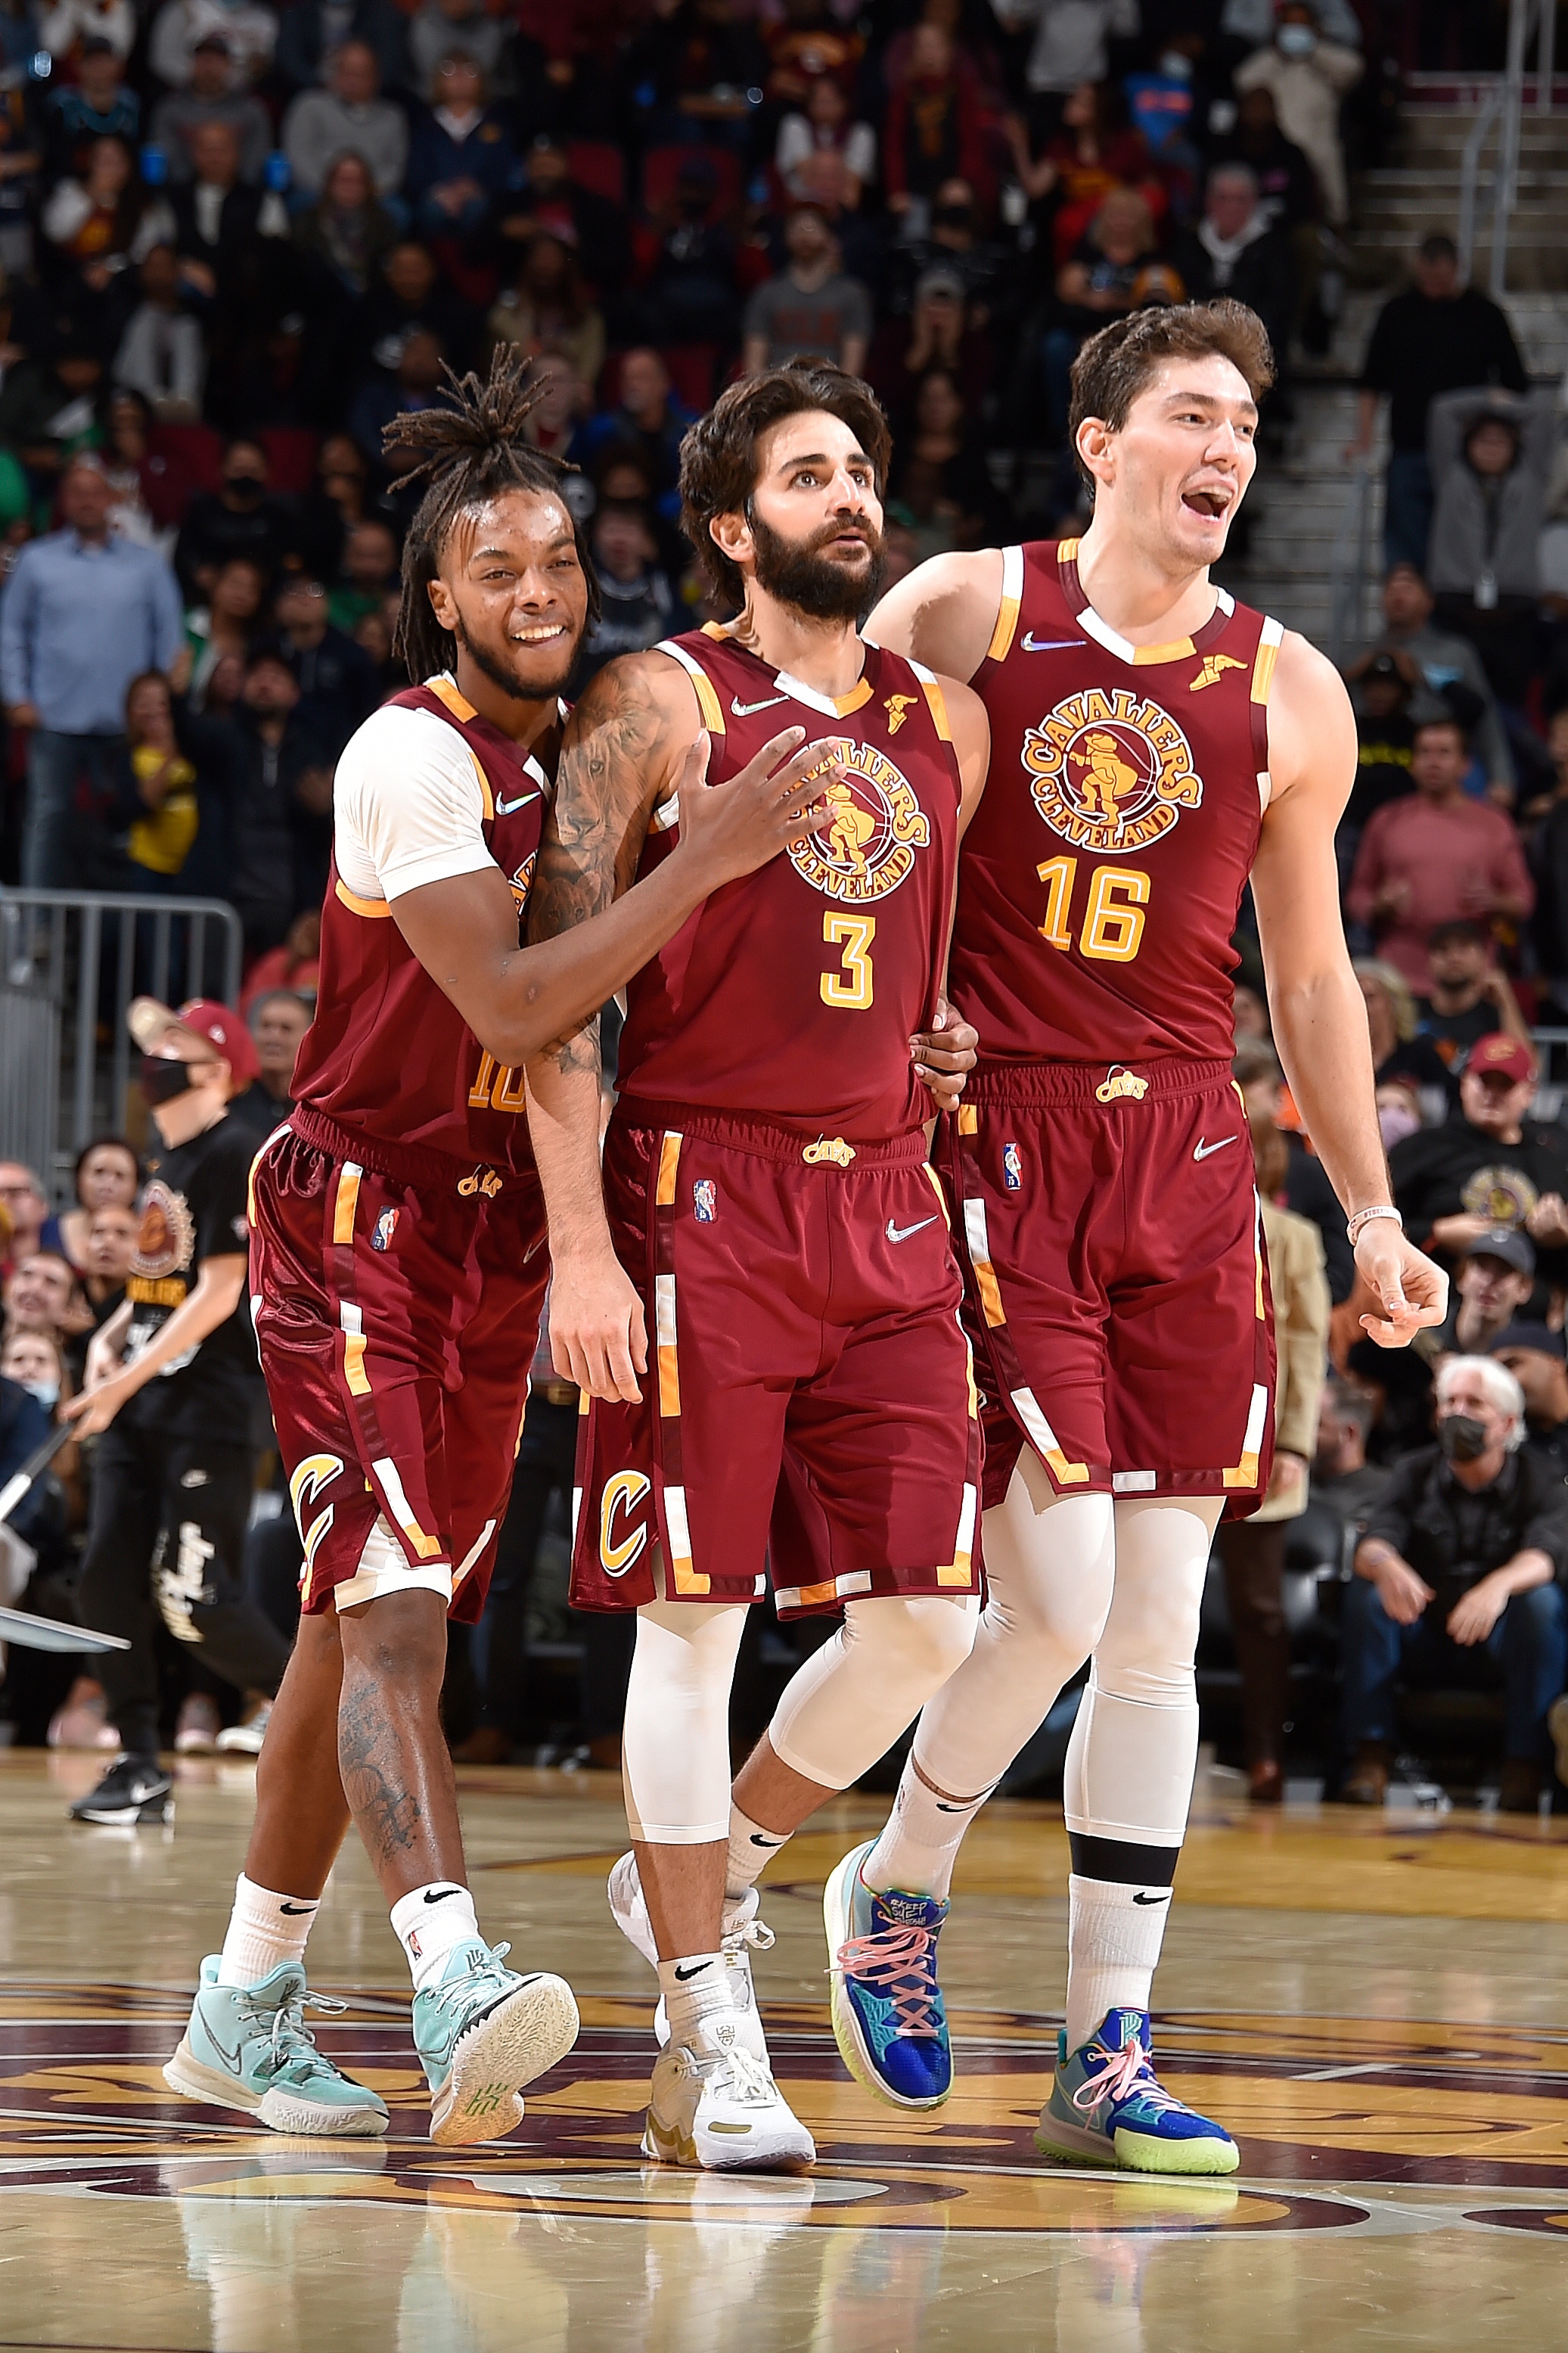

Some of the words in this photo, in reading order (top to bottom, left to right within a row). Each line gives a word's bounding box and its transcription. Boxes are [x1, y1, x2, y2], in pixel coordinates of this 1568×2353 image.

[788, 737, 930, 847] LIERS
[1022, 689, 1203, 807] CAVALIERS
[1031, 774, 1178, 853] CLEVELAND
[787, 836, 914, 902] CLEVELAND
[1036, 856, 1150, 962] 16
[820, 911, 876, 1010] 3
[1096, 1070, 1149, 1102] CAVS
[803, 1137, 856, 1167] CAVS
[600, 1470, 651, 1577] C
